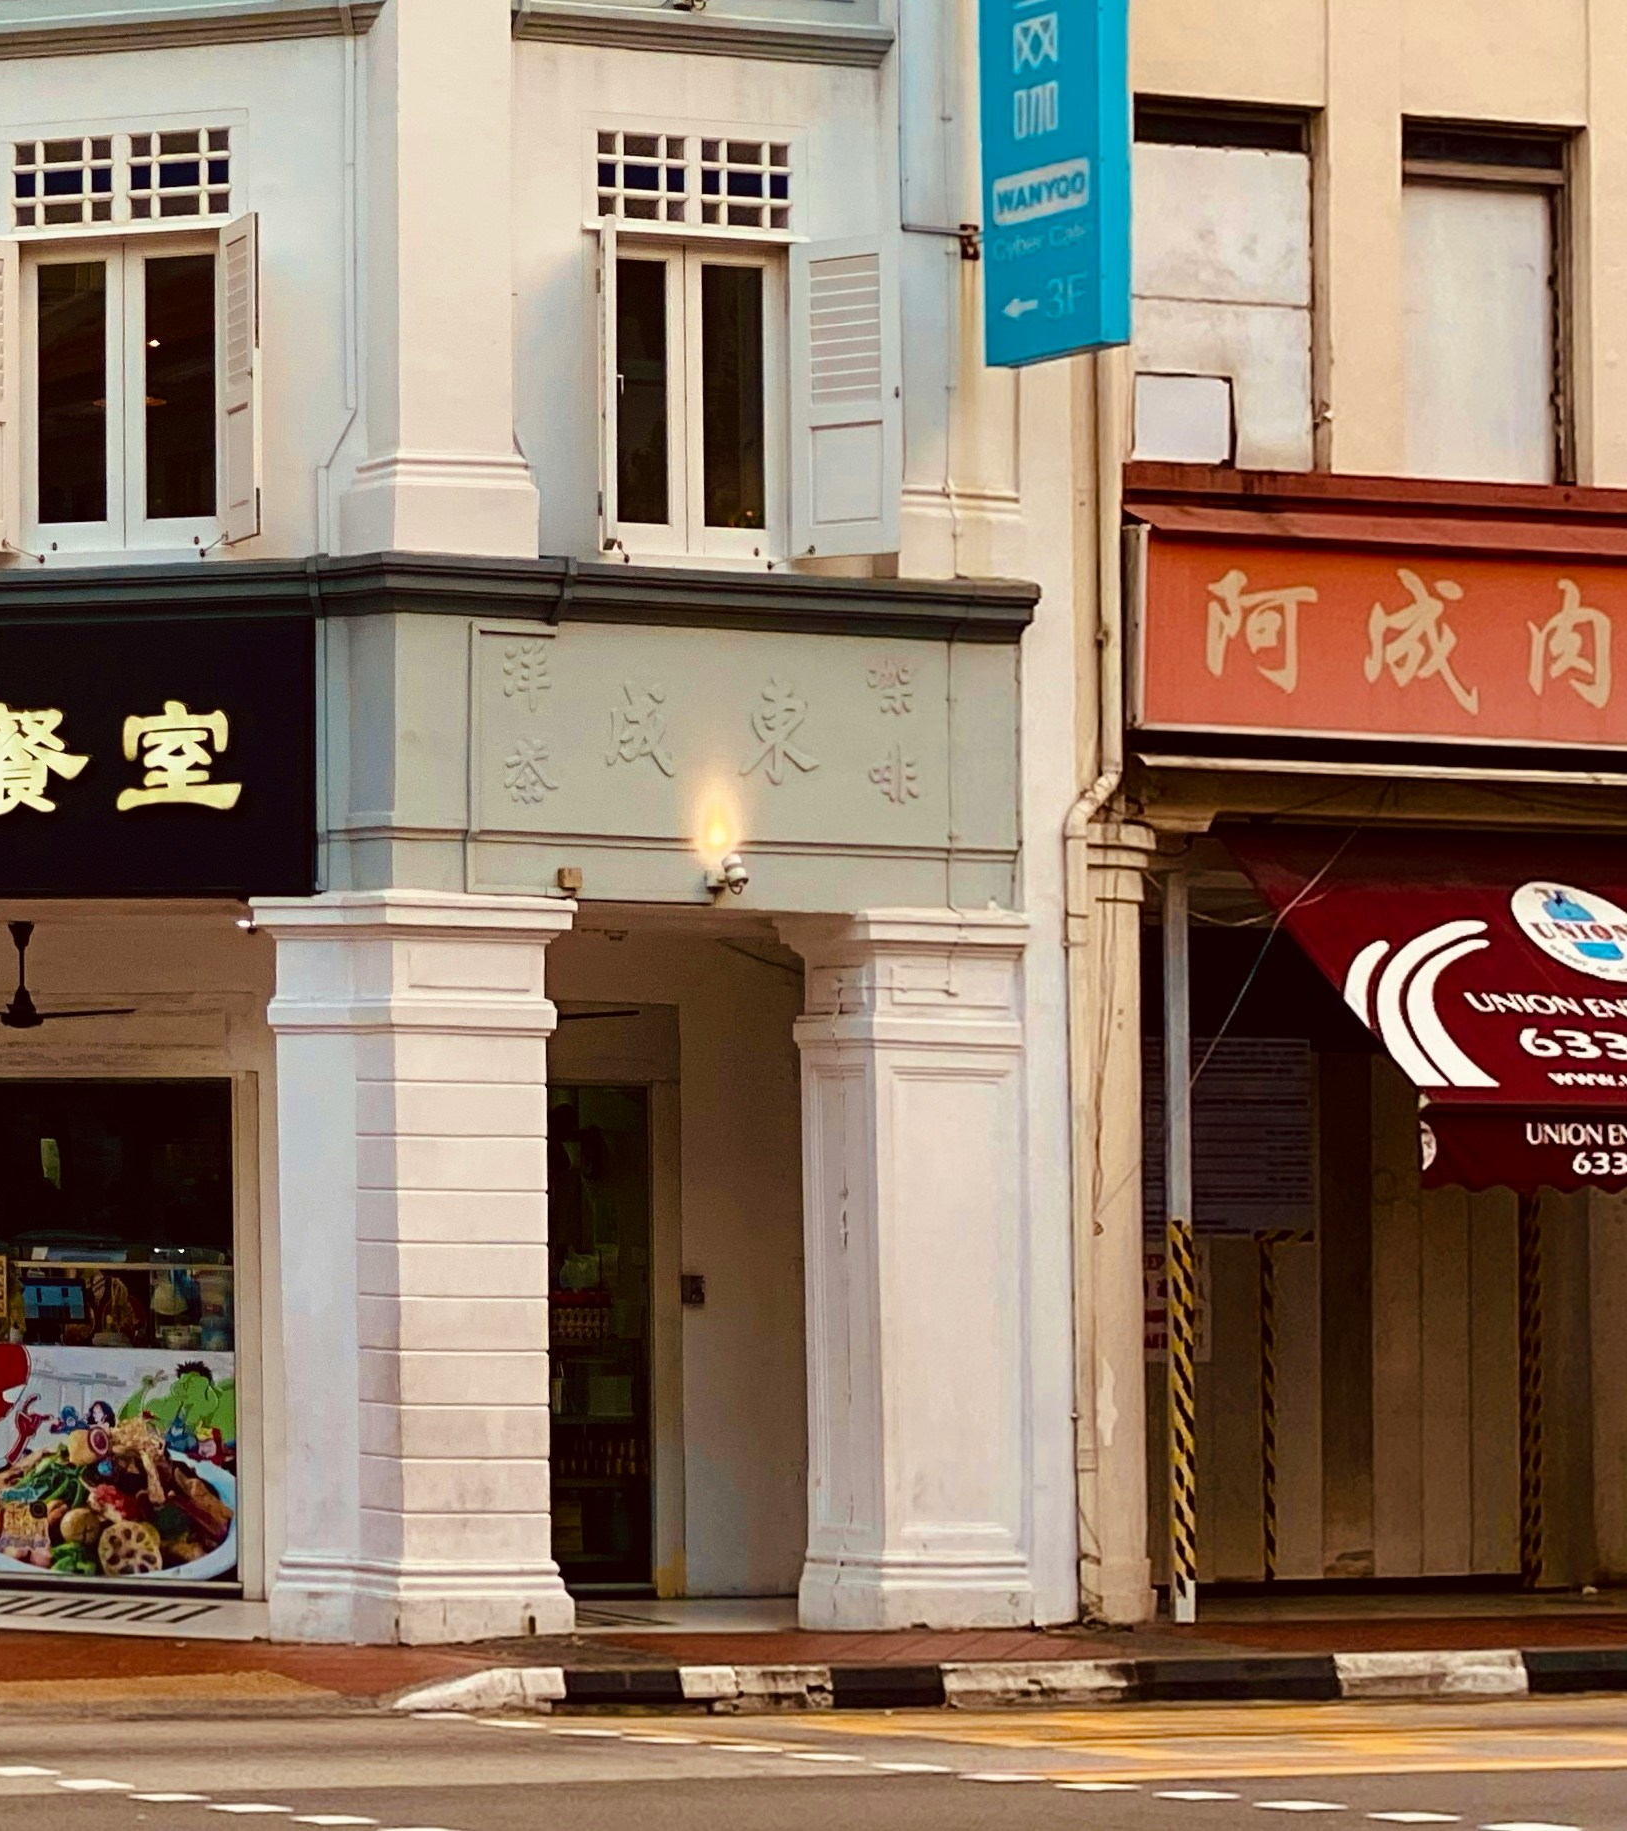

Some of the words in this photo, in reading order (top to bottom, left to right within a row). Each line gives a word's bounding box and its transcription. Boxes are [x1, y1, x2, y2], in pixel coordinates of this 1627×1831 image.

[996, 171, 1086, 215] WANYOO
[1046, 272, 1089, 319] 3F
[1206, 568, 1612, 717] 阿成肉
[1463, 991, 1585, 1017] UNION
[1525, 1122, 1604, 1146] UNION
